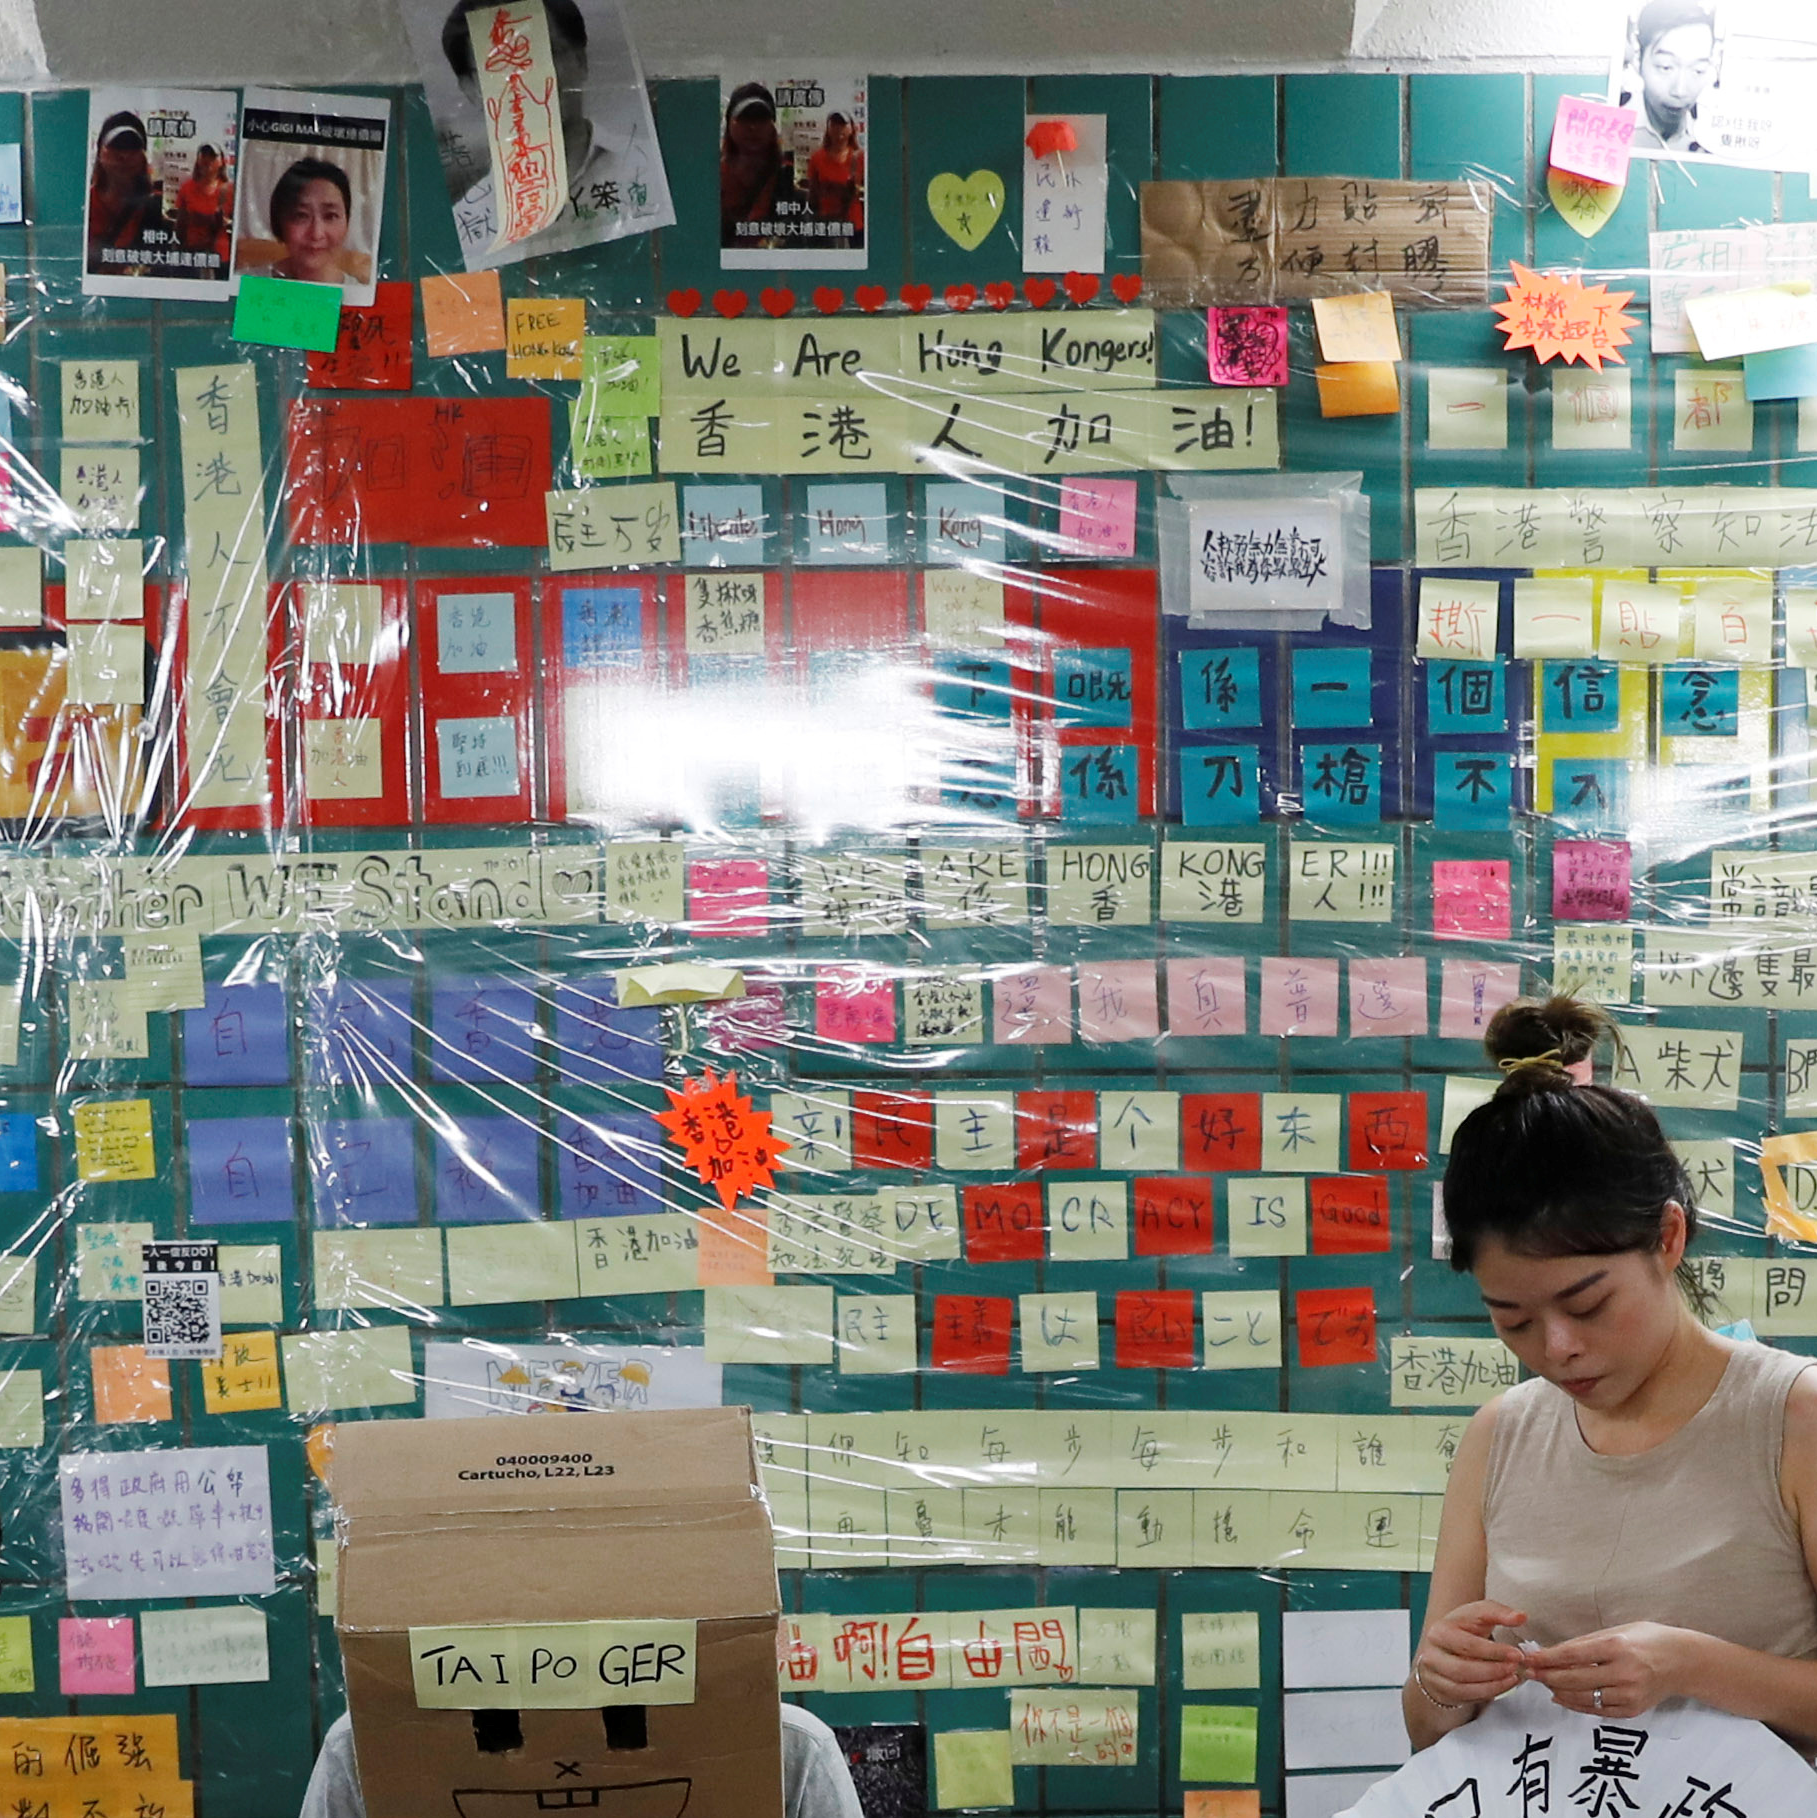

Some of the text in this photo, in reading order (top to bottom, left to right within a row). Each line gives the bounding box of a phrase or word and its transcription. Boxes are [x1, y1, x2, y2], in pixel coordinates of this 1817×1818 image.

[682, 328, 1156, 380] We Are Hong Kongers!
[693, 402, 1255, 464] 香港人加油!
[352, 849, 548, 926] Stand
[1062, 850, 1148, 882] HONG
[1180, 848, 1265, 879] KONG
[458, 1464, 615, 1482] Cartucho, L22, L23
[496, 1452, 593, 1466] 040009400
[420, 1643, 687, 1688] TAI PO GER
